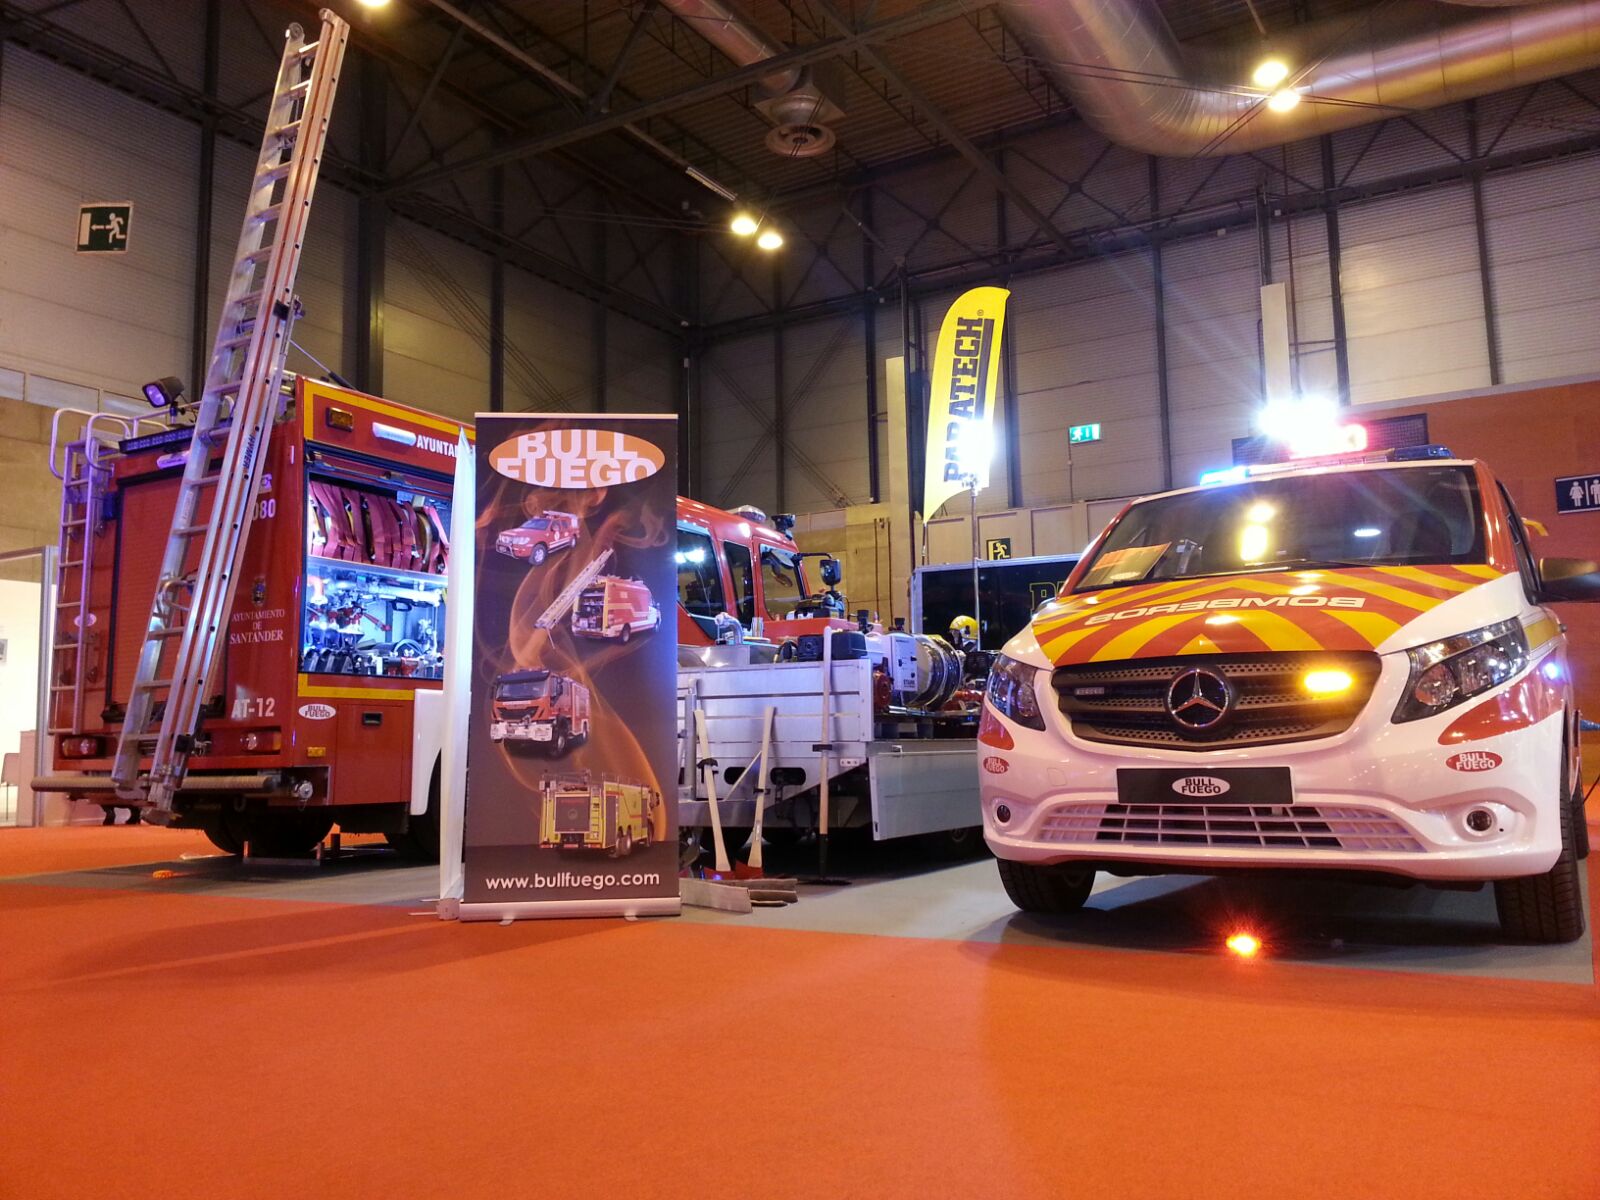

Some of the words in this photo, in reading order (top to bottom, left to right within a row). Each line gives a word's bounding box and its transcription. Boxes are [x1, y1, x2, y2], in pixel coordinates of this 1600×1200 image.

[517, 429, 638, 461] BULL
[497, 457, 657, 488] FUEGO
[232, 608, 285, 622] AYUNTAMIENTO
[253, 621, 262, 630] DE
[230, 629, 284, 644] SANTANDER
[231, 698, 275, 719] AT-12
[1459, 752, 1490, 762] BULL
[1456, 760, 1496, 771] FUEGO
[1185, 778, 1215, 786] BULL
[1181, 785, 1222, 794] FUEGO
[485, 872, 660, 890] www.bullfuego.com
